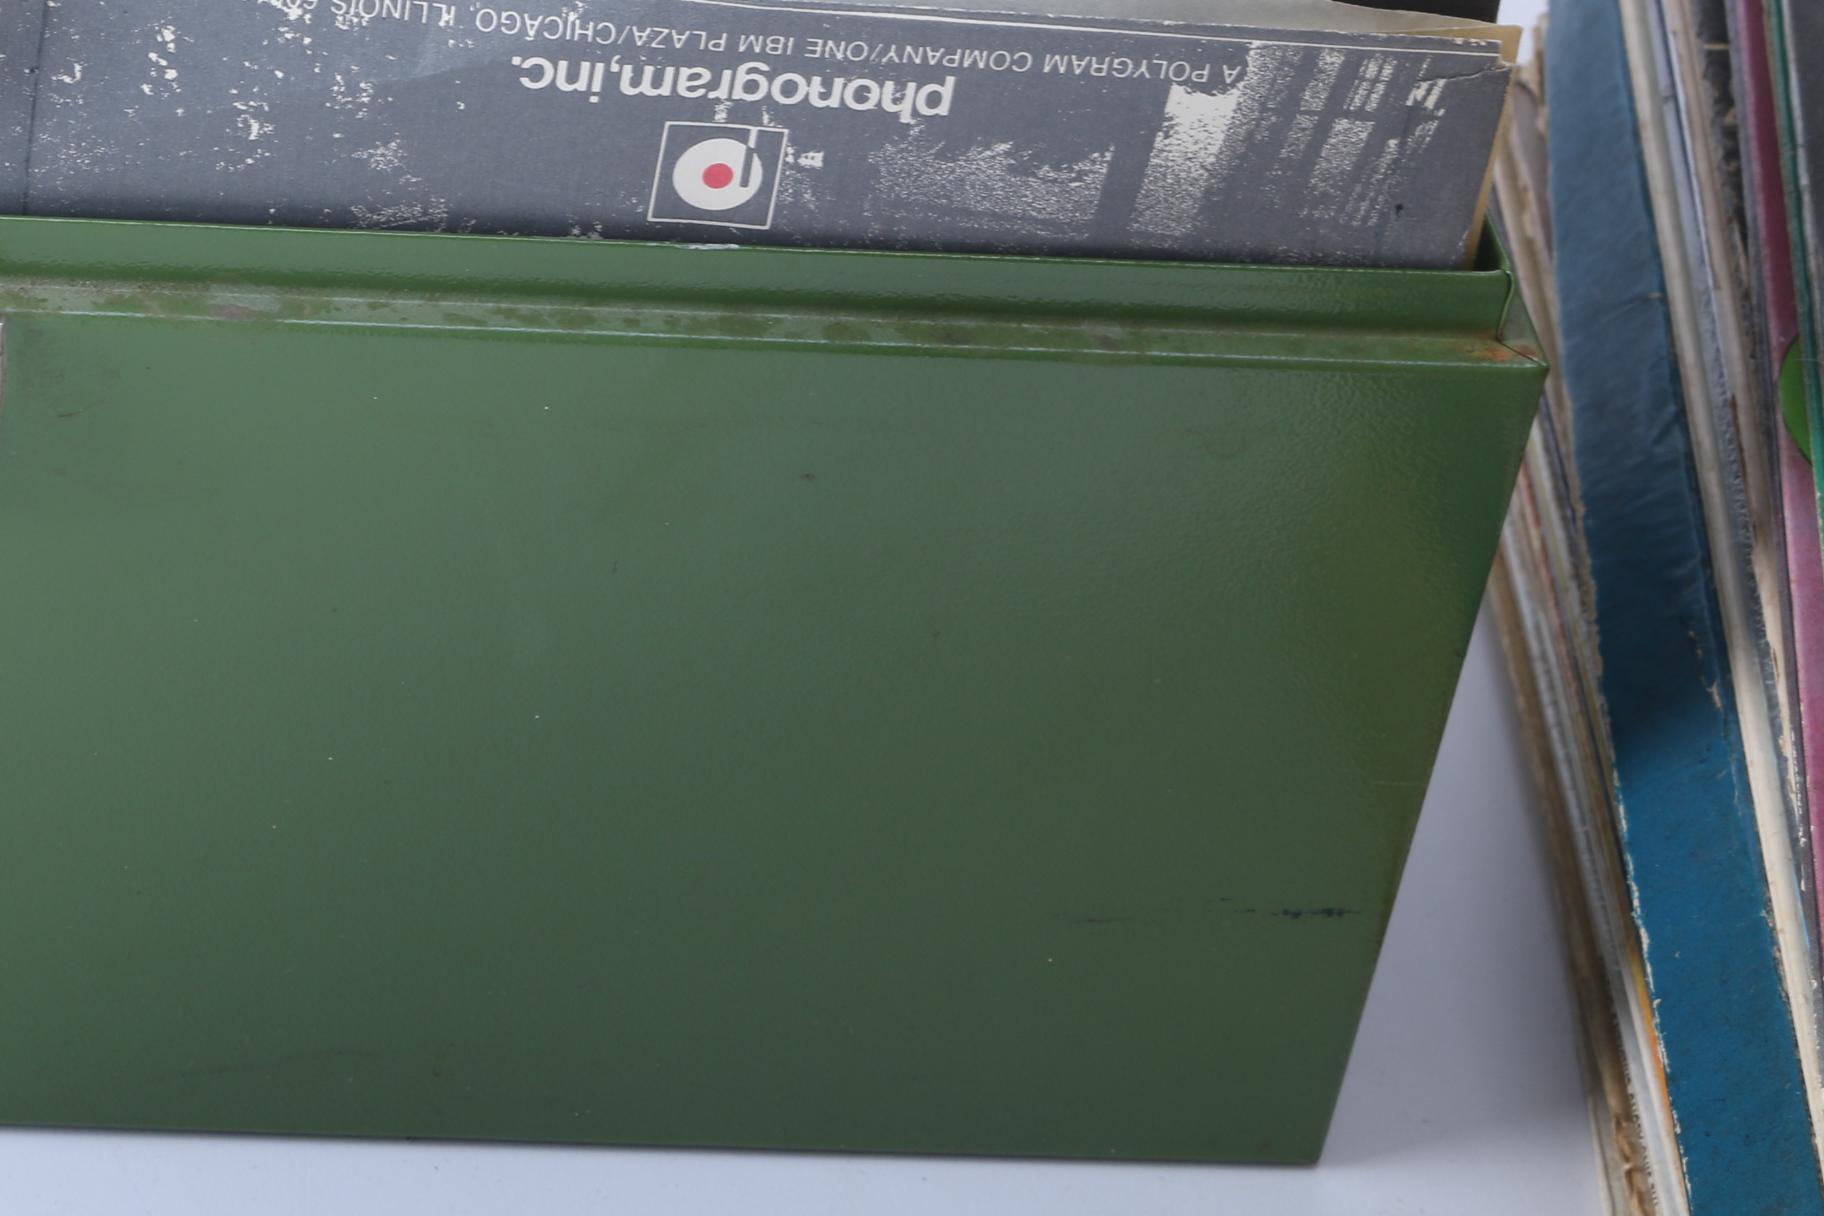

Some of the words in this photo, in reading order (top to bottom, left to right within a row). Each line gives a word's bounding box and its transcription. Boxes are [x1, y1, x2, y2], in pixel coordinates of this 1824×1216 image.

[738, 33, 793, 56] IBM
[1043, 54, 1210, 84] POLYGRAM
[1222, 65, 1242, 84] A
